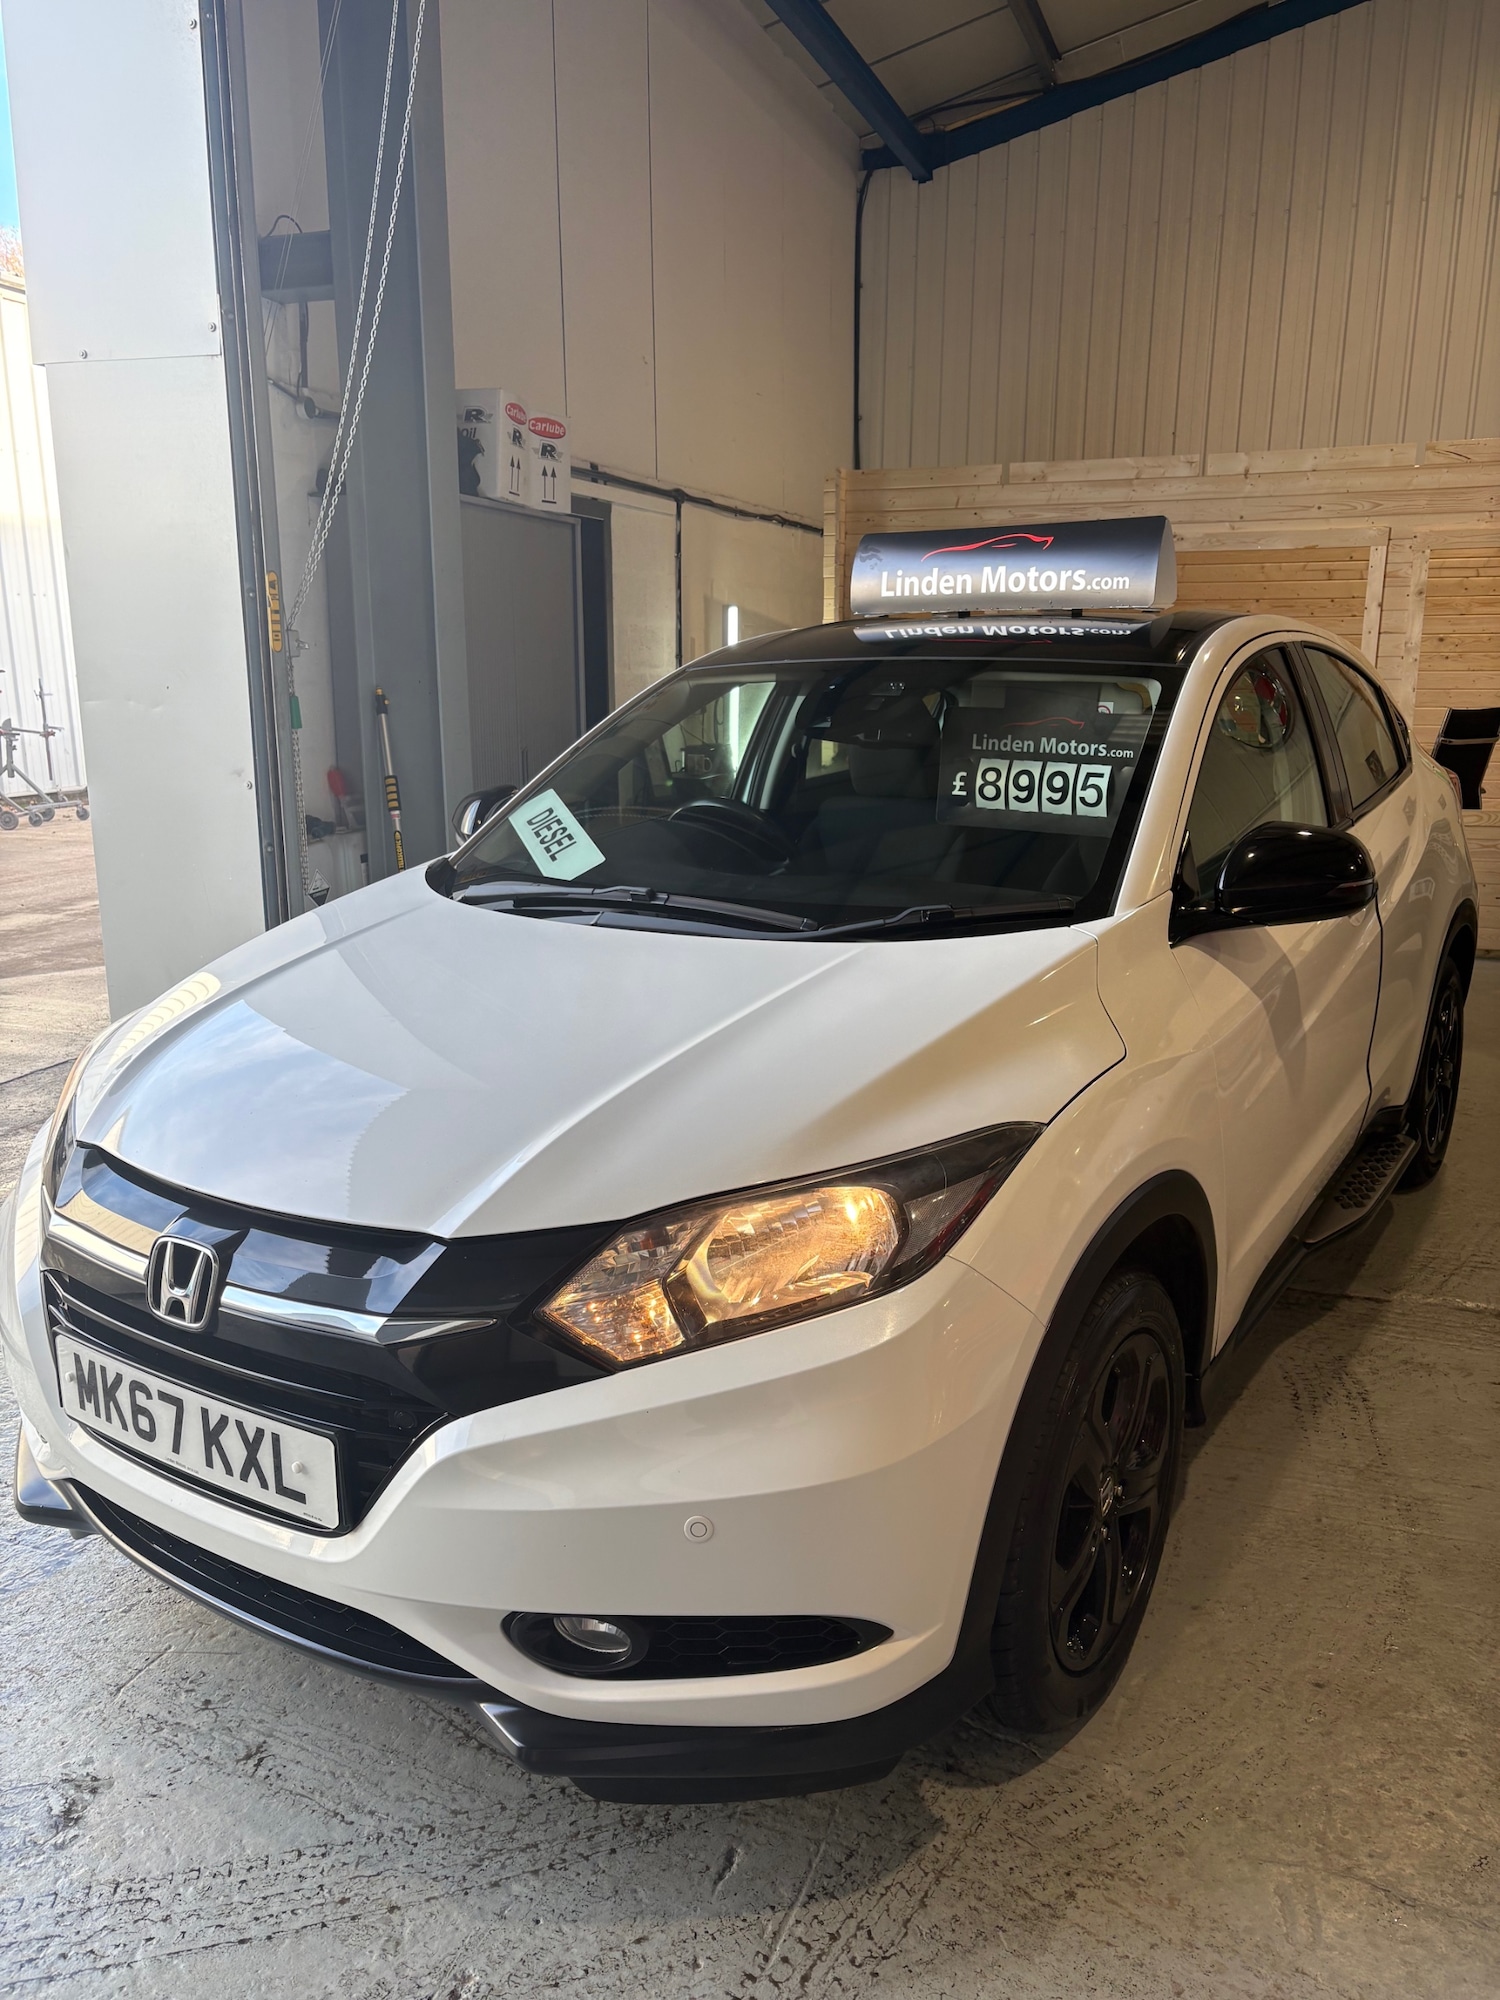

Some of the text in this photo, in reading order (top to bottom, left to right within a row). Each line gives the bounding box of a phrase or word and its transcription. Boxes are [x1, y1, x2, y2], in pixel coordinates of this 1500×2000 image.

[529, 420, 565, 436] Carlube
[880, 565, 1130, 597] Linden Motors.com
[972, 733, 1134, 759] Linden Motors.com
[526, 807, 577, 863] DIESEL
[73, 1352, 307, 1505] MK67 KXL
